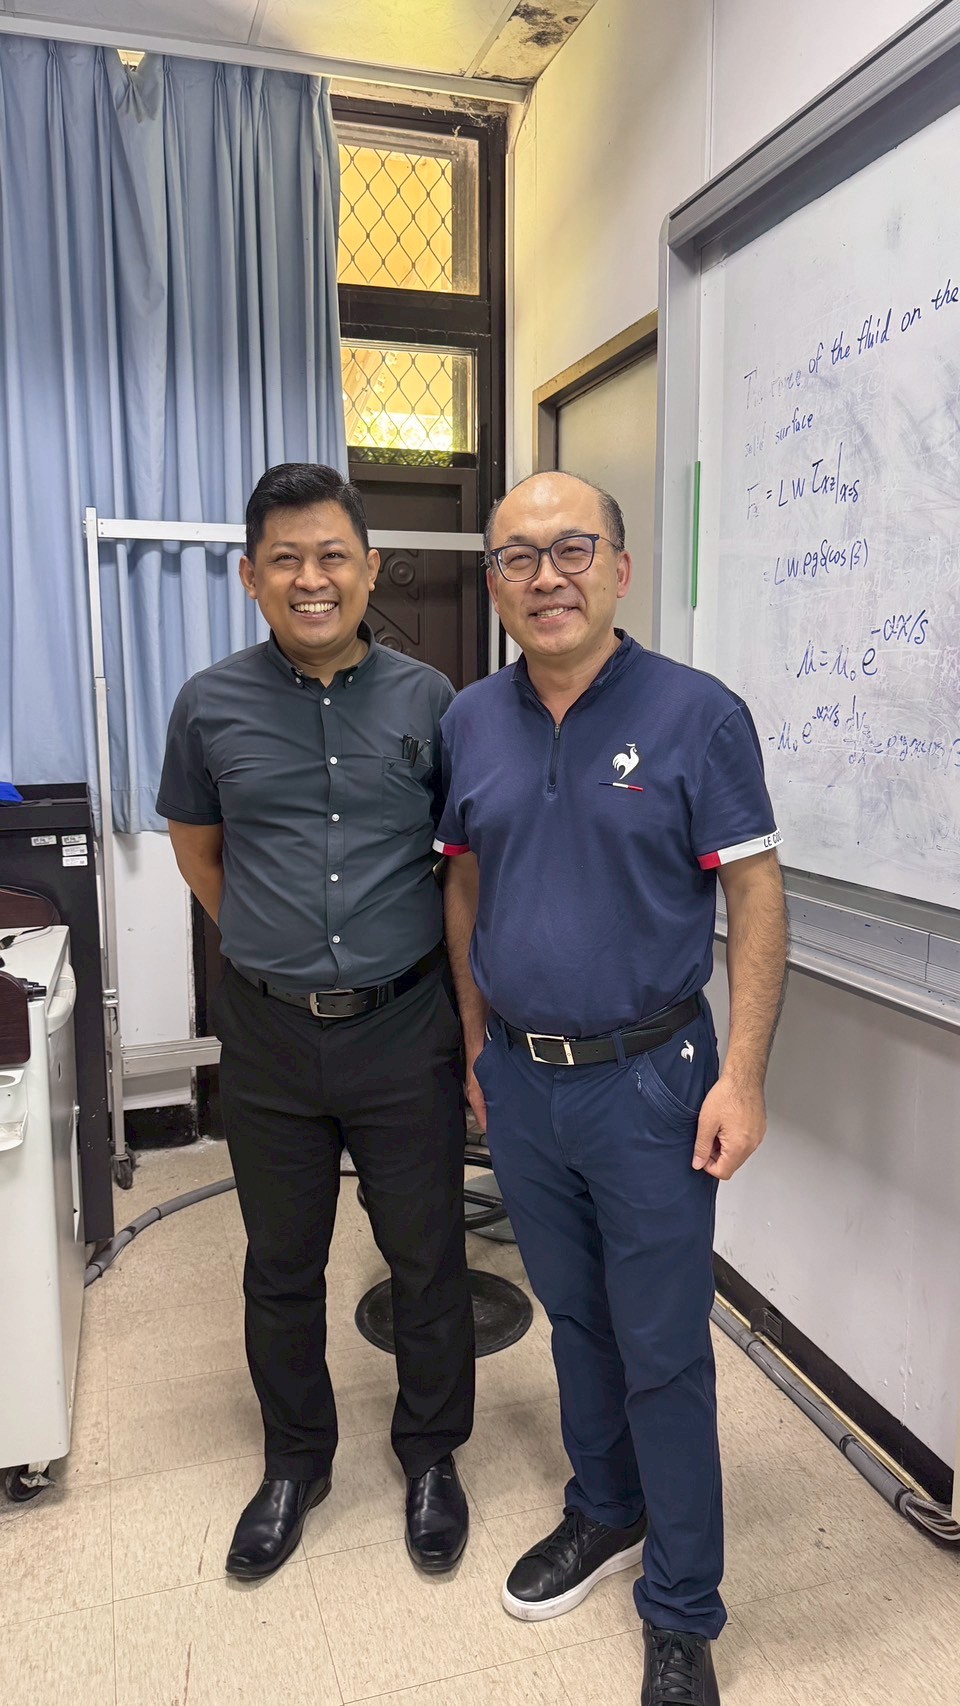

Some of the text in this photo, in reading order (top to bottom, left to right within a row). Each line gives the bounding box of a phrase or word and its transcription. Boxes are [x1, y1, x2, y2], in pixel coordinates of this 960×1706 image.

[808, 342, 824, 374] of
[831, 331, 850, 365] the
[857, 308, 892, 355] fluid
[901, 307, 921, 332] on
[931, 279, 959, 311] the
[775, 407, 814, 445] surface
[763, 836, 773, 848] LE
